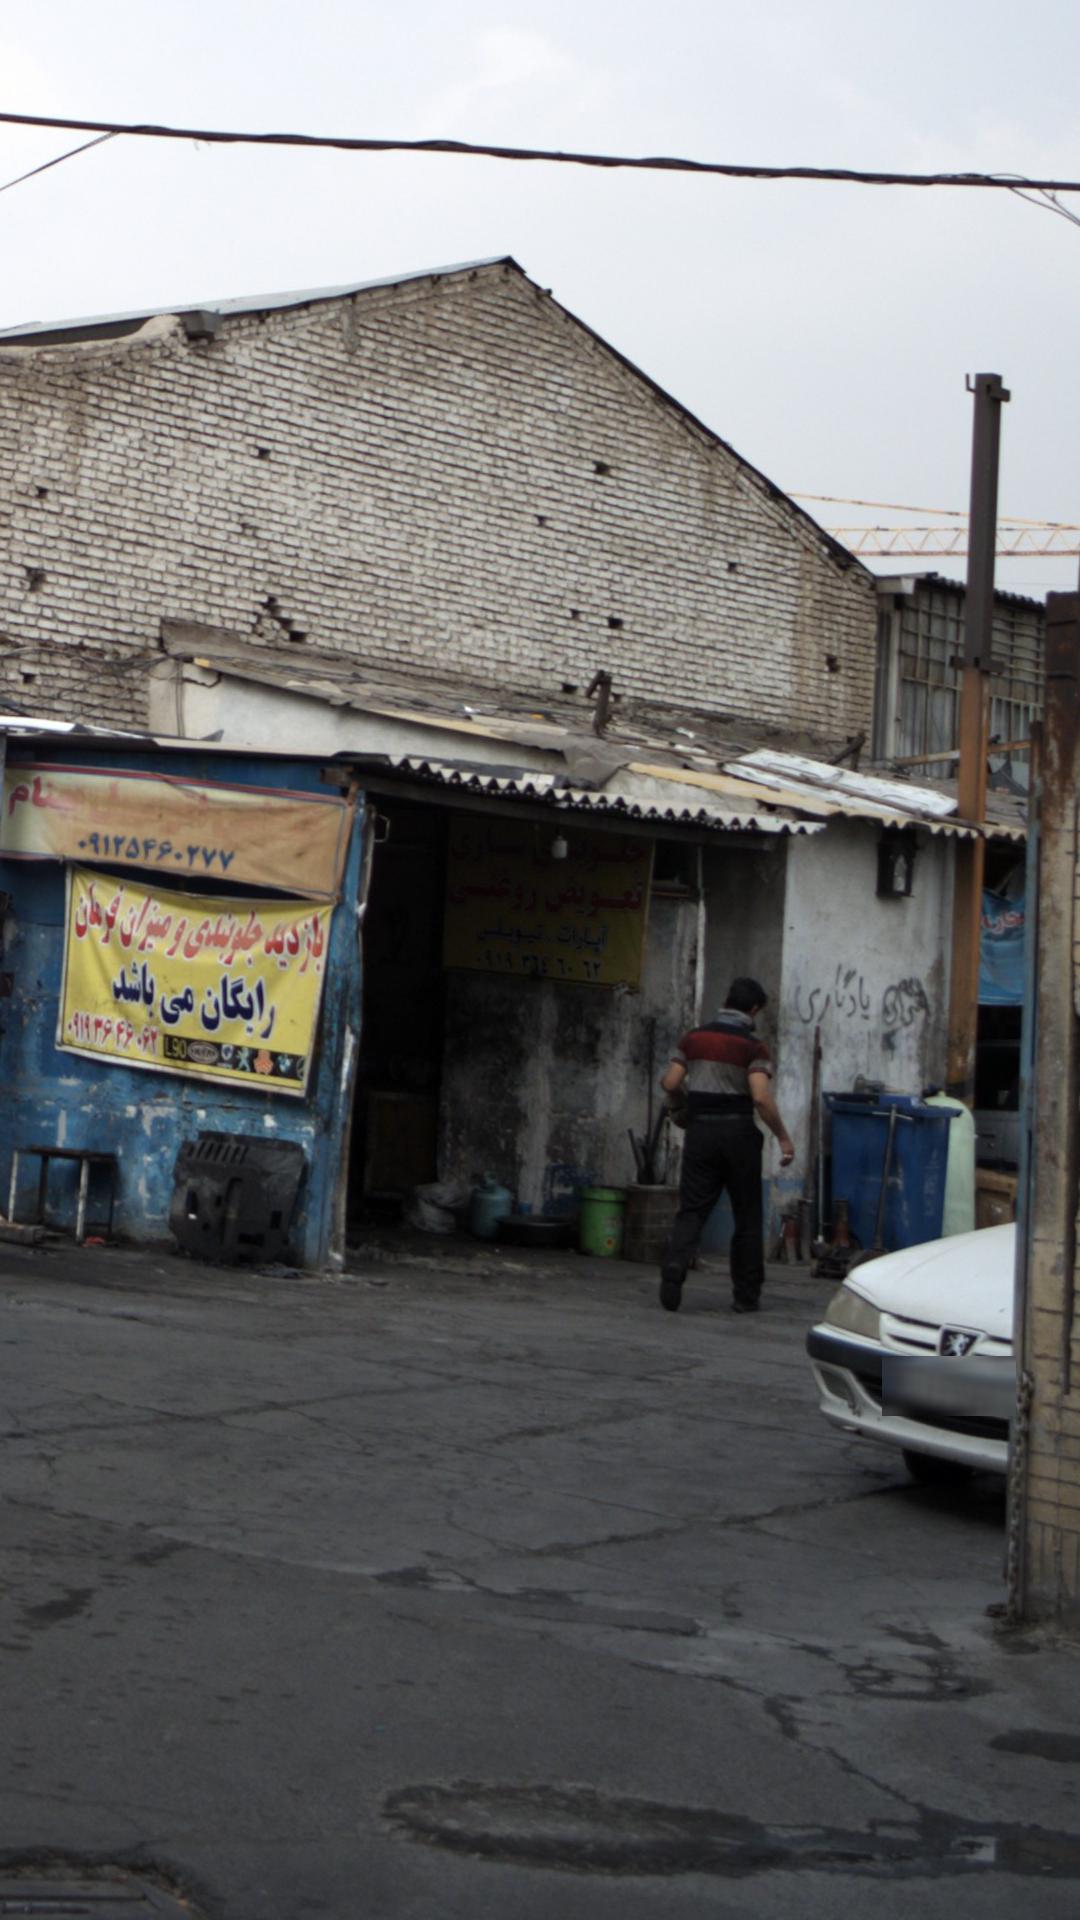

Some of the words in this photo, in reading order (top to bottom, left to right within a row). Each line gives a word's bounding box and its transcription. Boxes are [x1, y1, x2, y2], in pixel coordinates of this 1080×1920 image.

[166, 919, 187, 957] و
[183, 909, 262, 965] جلوبندی
[112, 961, 154, 1018] باشد
[201, 974, 275, 1039] رایگان
